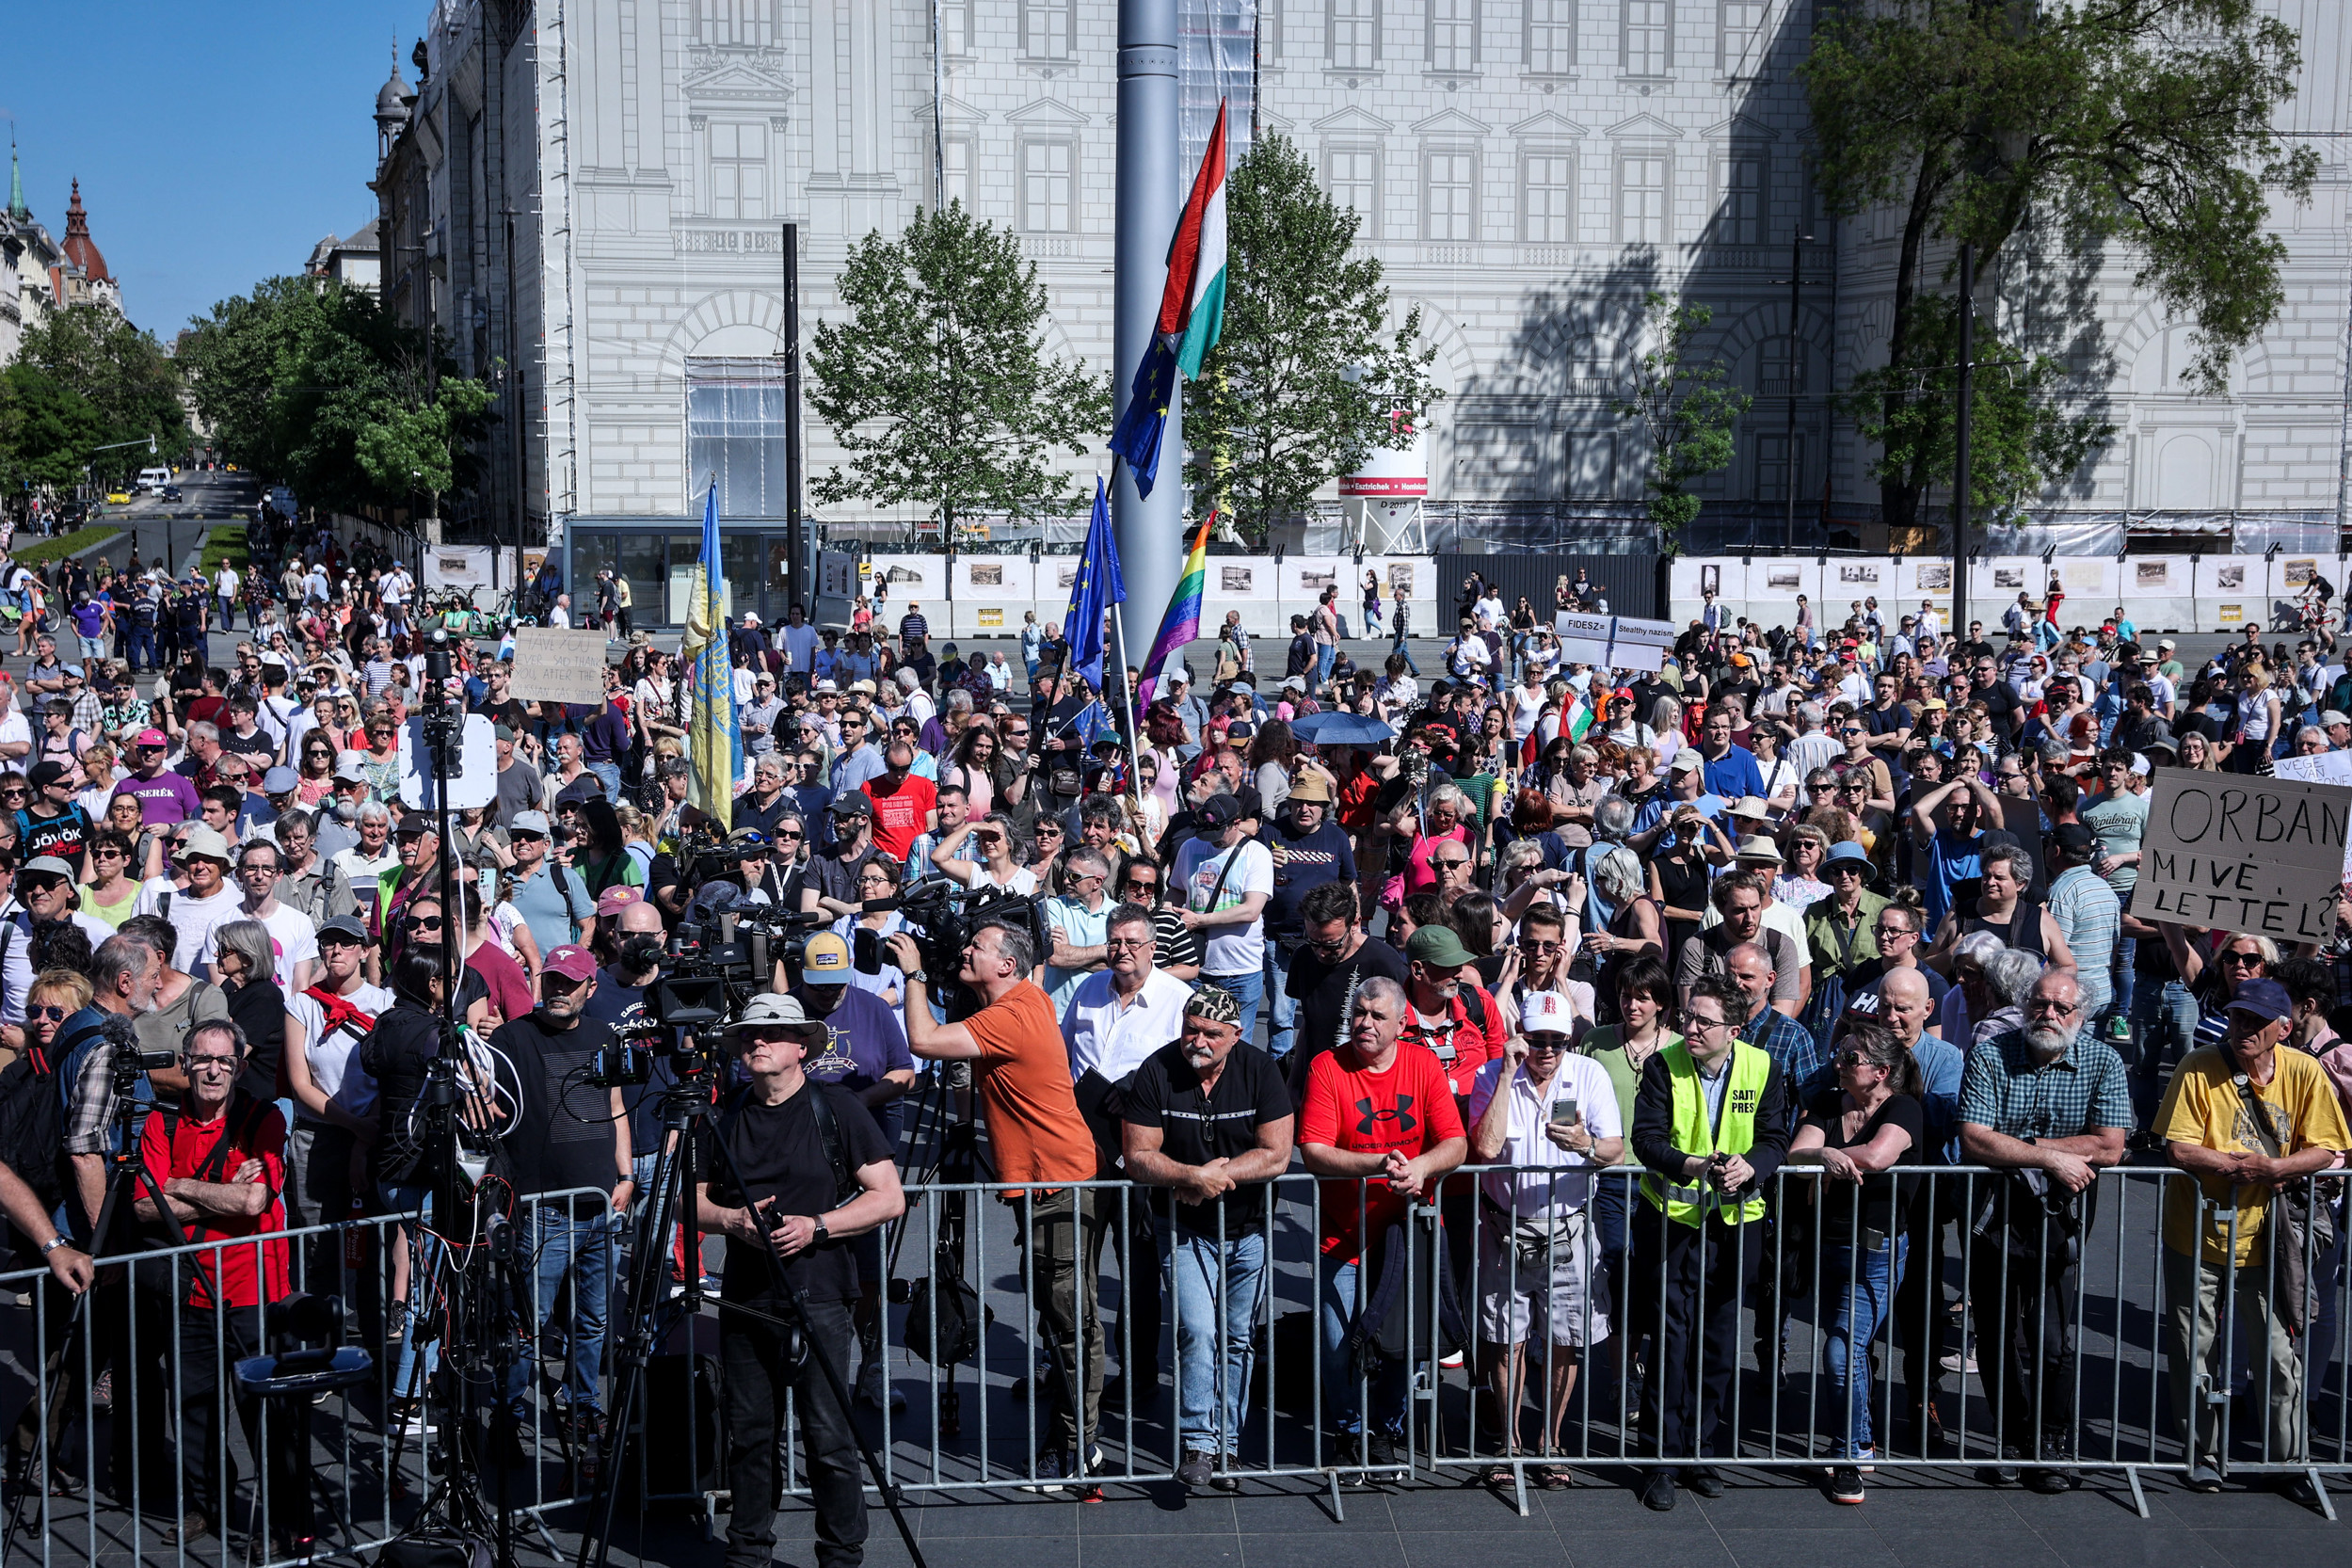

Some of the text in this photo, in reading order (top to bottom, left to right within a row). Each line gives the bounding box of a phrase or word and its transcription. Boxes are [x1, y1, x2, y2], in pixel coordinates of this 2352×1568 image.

[1389, 501, 1408, 509] 2015
[1618, 624, 1648, 636] Stealthy
[1648, 629, 1674, 638] nazism
[518, 632, 590, 653] HAVE YOU
[515, 653, 543, 666] EVER
[574, 655, 603, 669] THANK
[514, 668, 597, 682] YOU, AFTER THE
[511, 681, 551, 697] RUSSIAN
[554, 687, 570, 700] GAS
[2282, 756, 2325, 771] VÉGE
[2296, 767, 2325, 779] VAN
[2170, 787, 2348, 849] ORBÁN
[2152, 853, 2259, 891] MIVÉ
[2153, 887, 2334, 938] LETTÉL?
[1733, 1089, 1756, 1101] SAJT
[1384, 1135, 1420, 1149] ARMOUR
